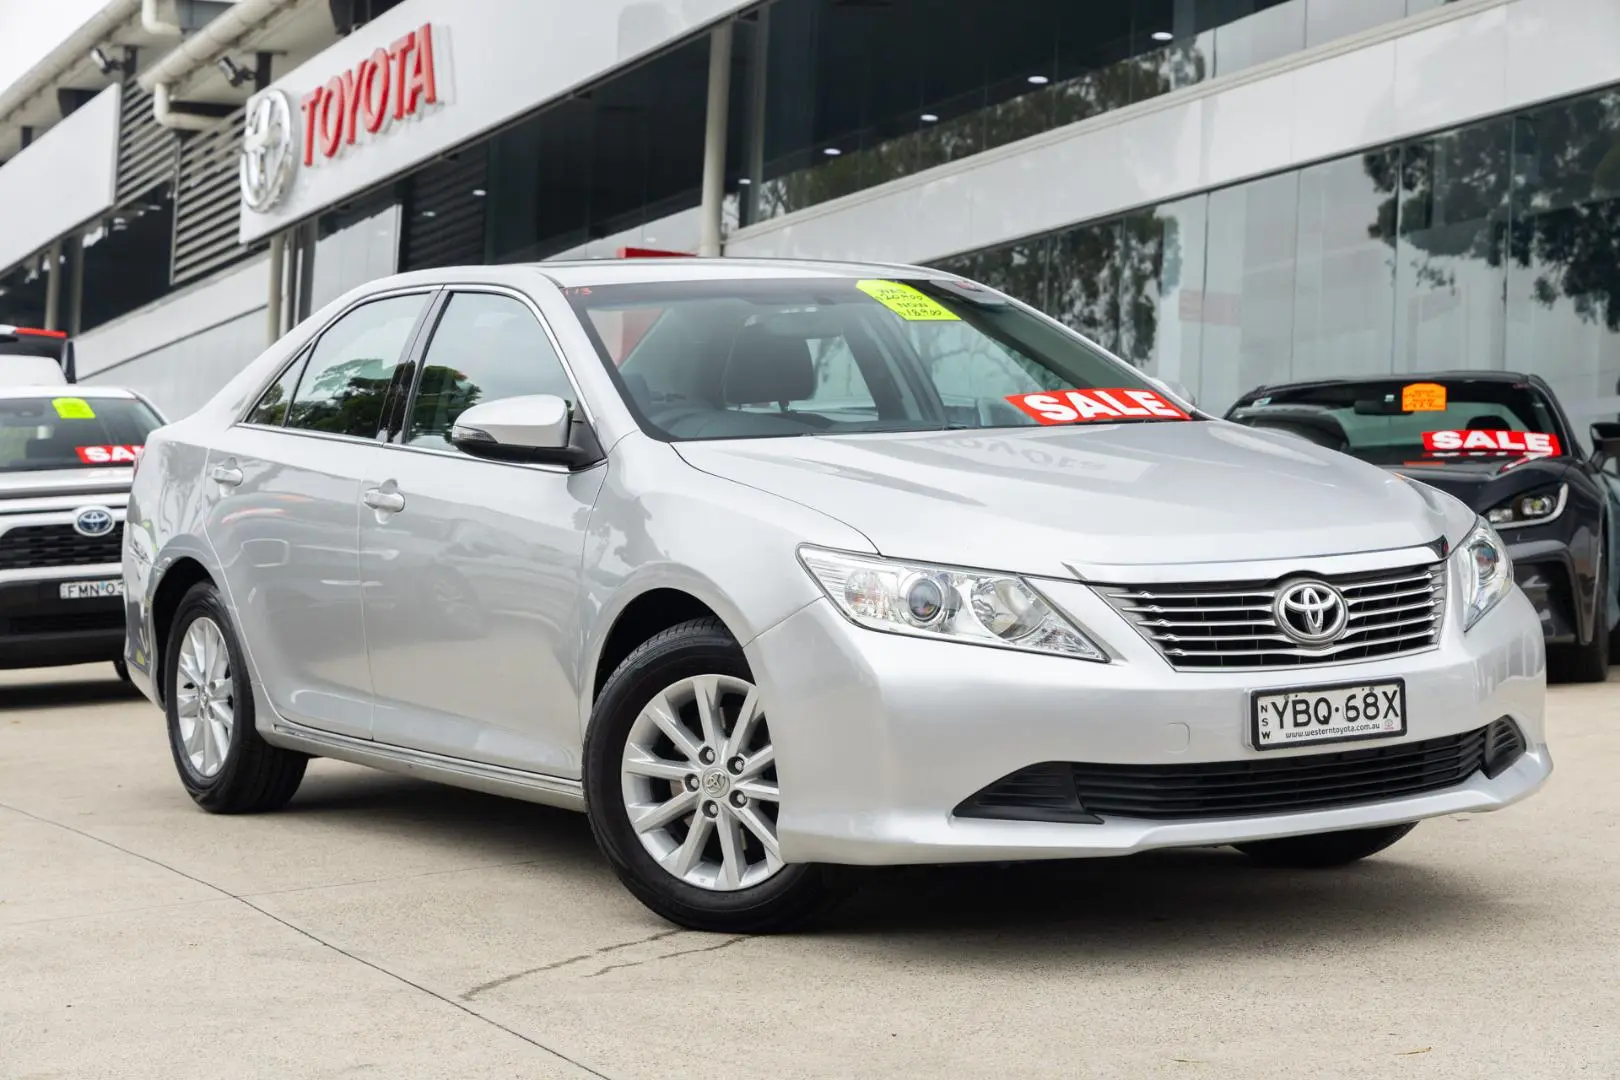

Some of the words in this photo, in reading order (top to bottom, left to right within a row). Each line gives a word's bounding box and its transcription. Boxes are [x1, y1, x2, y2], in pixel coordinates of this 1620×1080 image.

[301, 22, 436, 167] TOYOTA
[1023, 390, 1181, 421] SALE
[1432, 430, 1553, 454] SALE
[1285, 722, 1380, 739] www.westerntoyota.com.au
